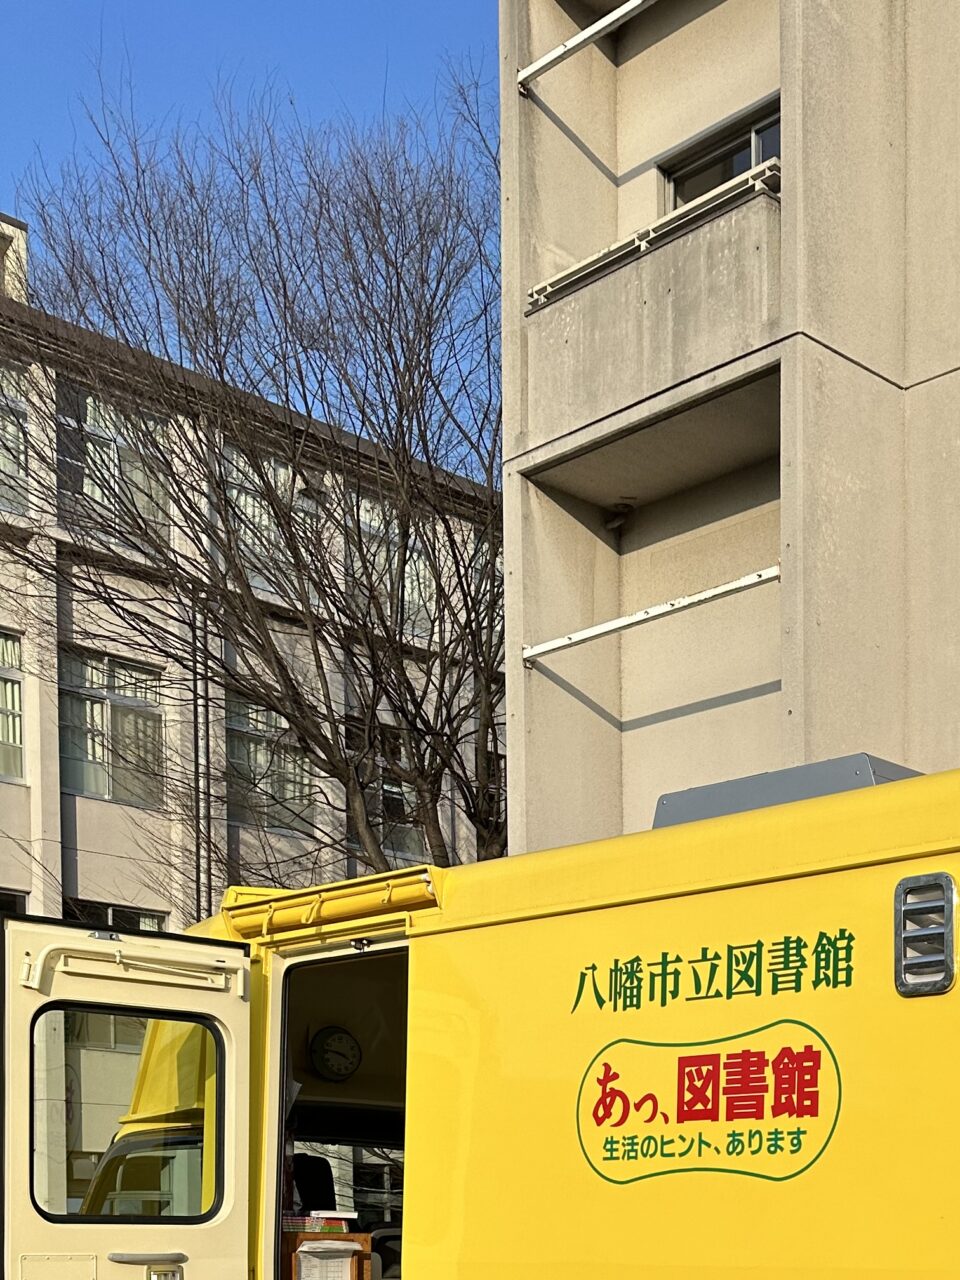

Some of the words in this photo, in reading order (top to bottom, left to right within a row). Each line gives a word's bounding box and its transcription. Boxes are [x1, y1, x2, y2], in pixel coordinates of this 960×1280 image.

[570, 927, 856, 1015] 八幡市立図書館
[592, 1045, 822, 1128] あっ、図書館
[602, 1126, 808, 1163] 生活のヒント、あります
